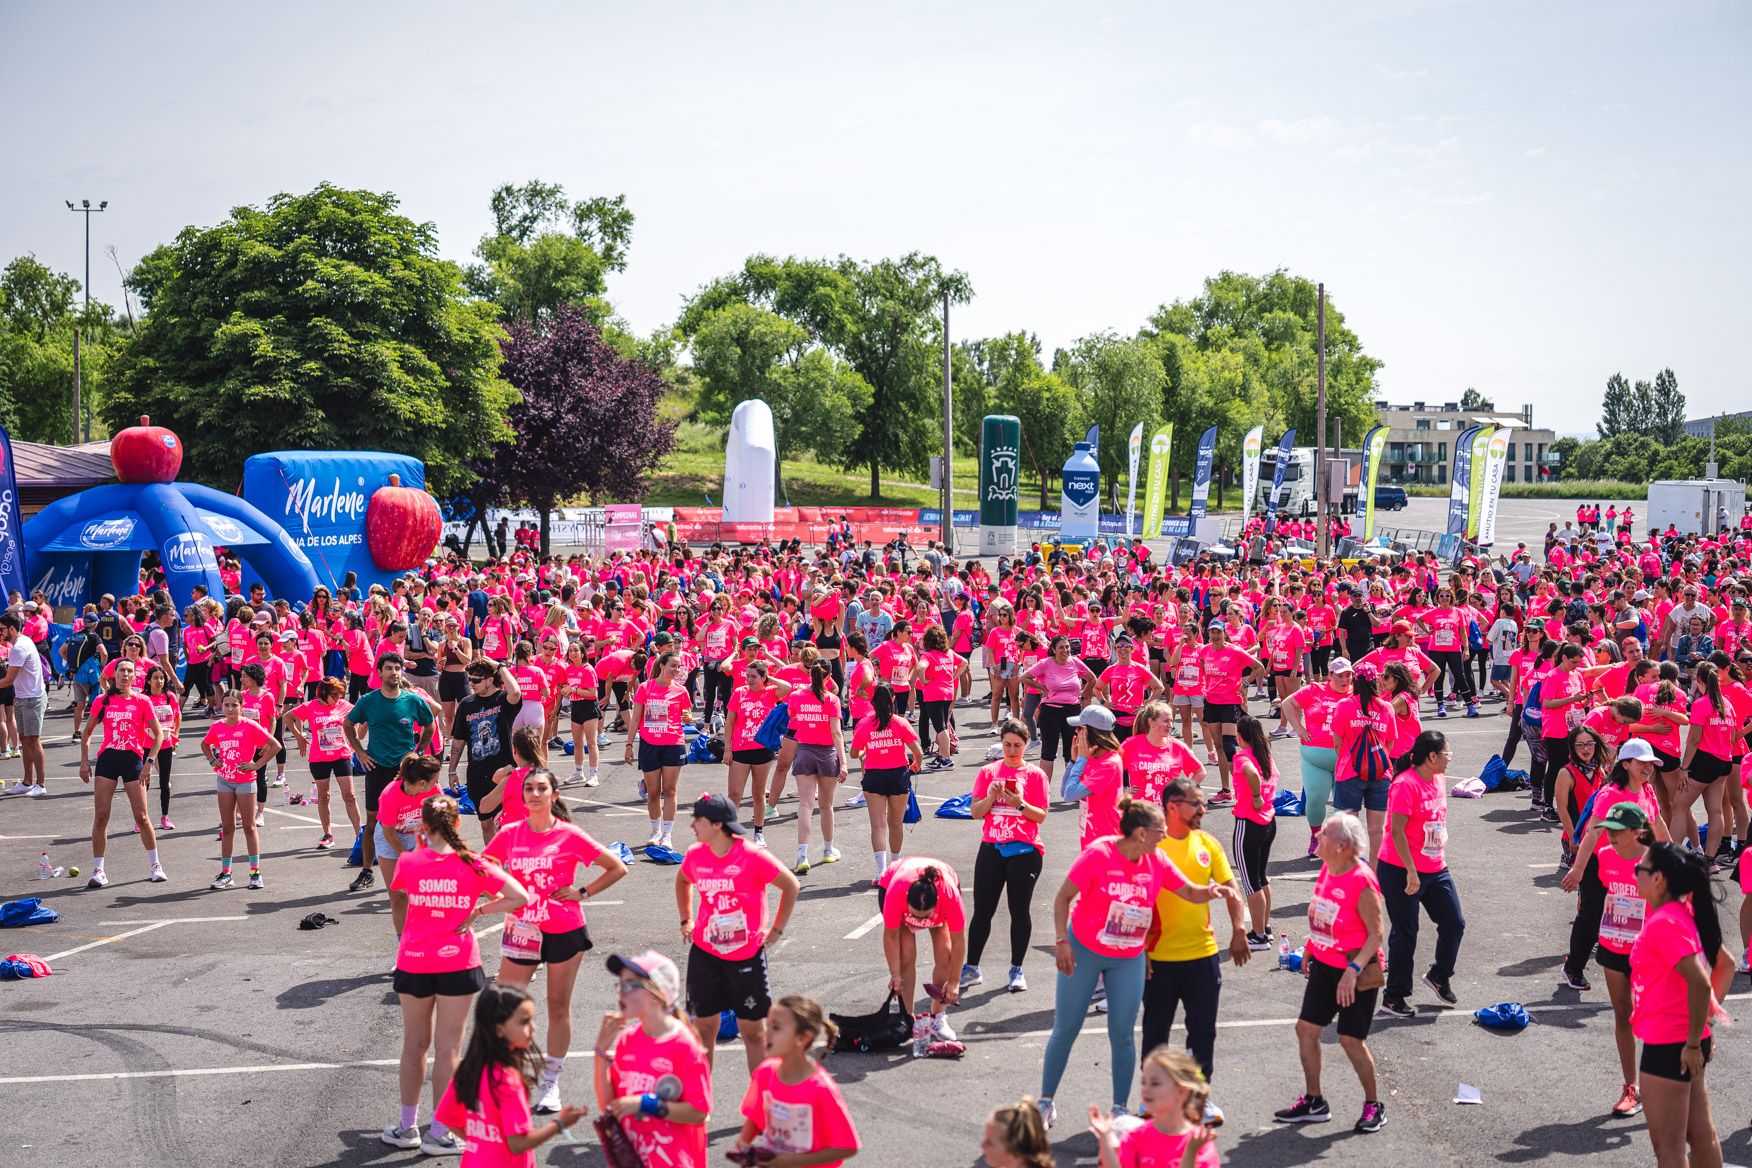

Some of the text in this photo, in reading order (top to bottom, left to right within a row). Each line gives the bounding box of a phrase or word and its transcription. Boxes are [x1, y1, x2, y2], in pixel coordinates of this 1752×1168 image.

[1068, 482, 1094, 490] next
[1490, 486, 1496, 496] TU
[285, 477, 364, 534] Marlene
[1489, 497, 1494, 508] EN
[85, 524, 129, 540] Marlene
[1484, 512, 1492, 539] AMUTIO
[307, 536, 320, 547] DE
[321, 536, 338, 546] LOS
[339, 534, 362, 545] ALPES
[102, 626, 112, 640] 0
[800, 704, 822, 713] SOMOS
[106, 711, 132, 720] CARRERA
[120, 722, 128, 732] DE
[870, 730, 892, 740] SOMOS
[1138, 761, 1170, 772] CARRERA
[1155, 775, 1164, 786] DE
[511, 857, 552, 870] CARRERA
[418, 879, 458, 894] SOMOS
[697, 879, 734, 892] CARRERA
[1108, 882, 1148, 900] CARRERA
[718, 895, 730, 911] DE
